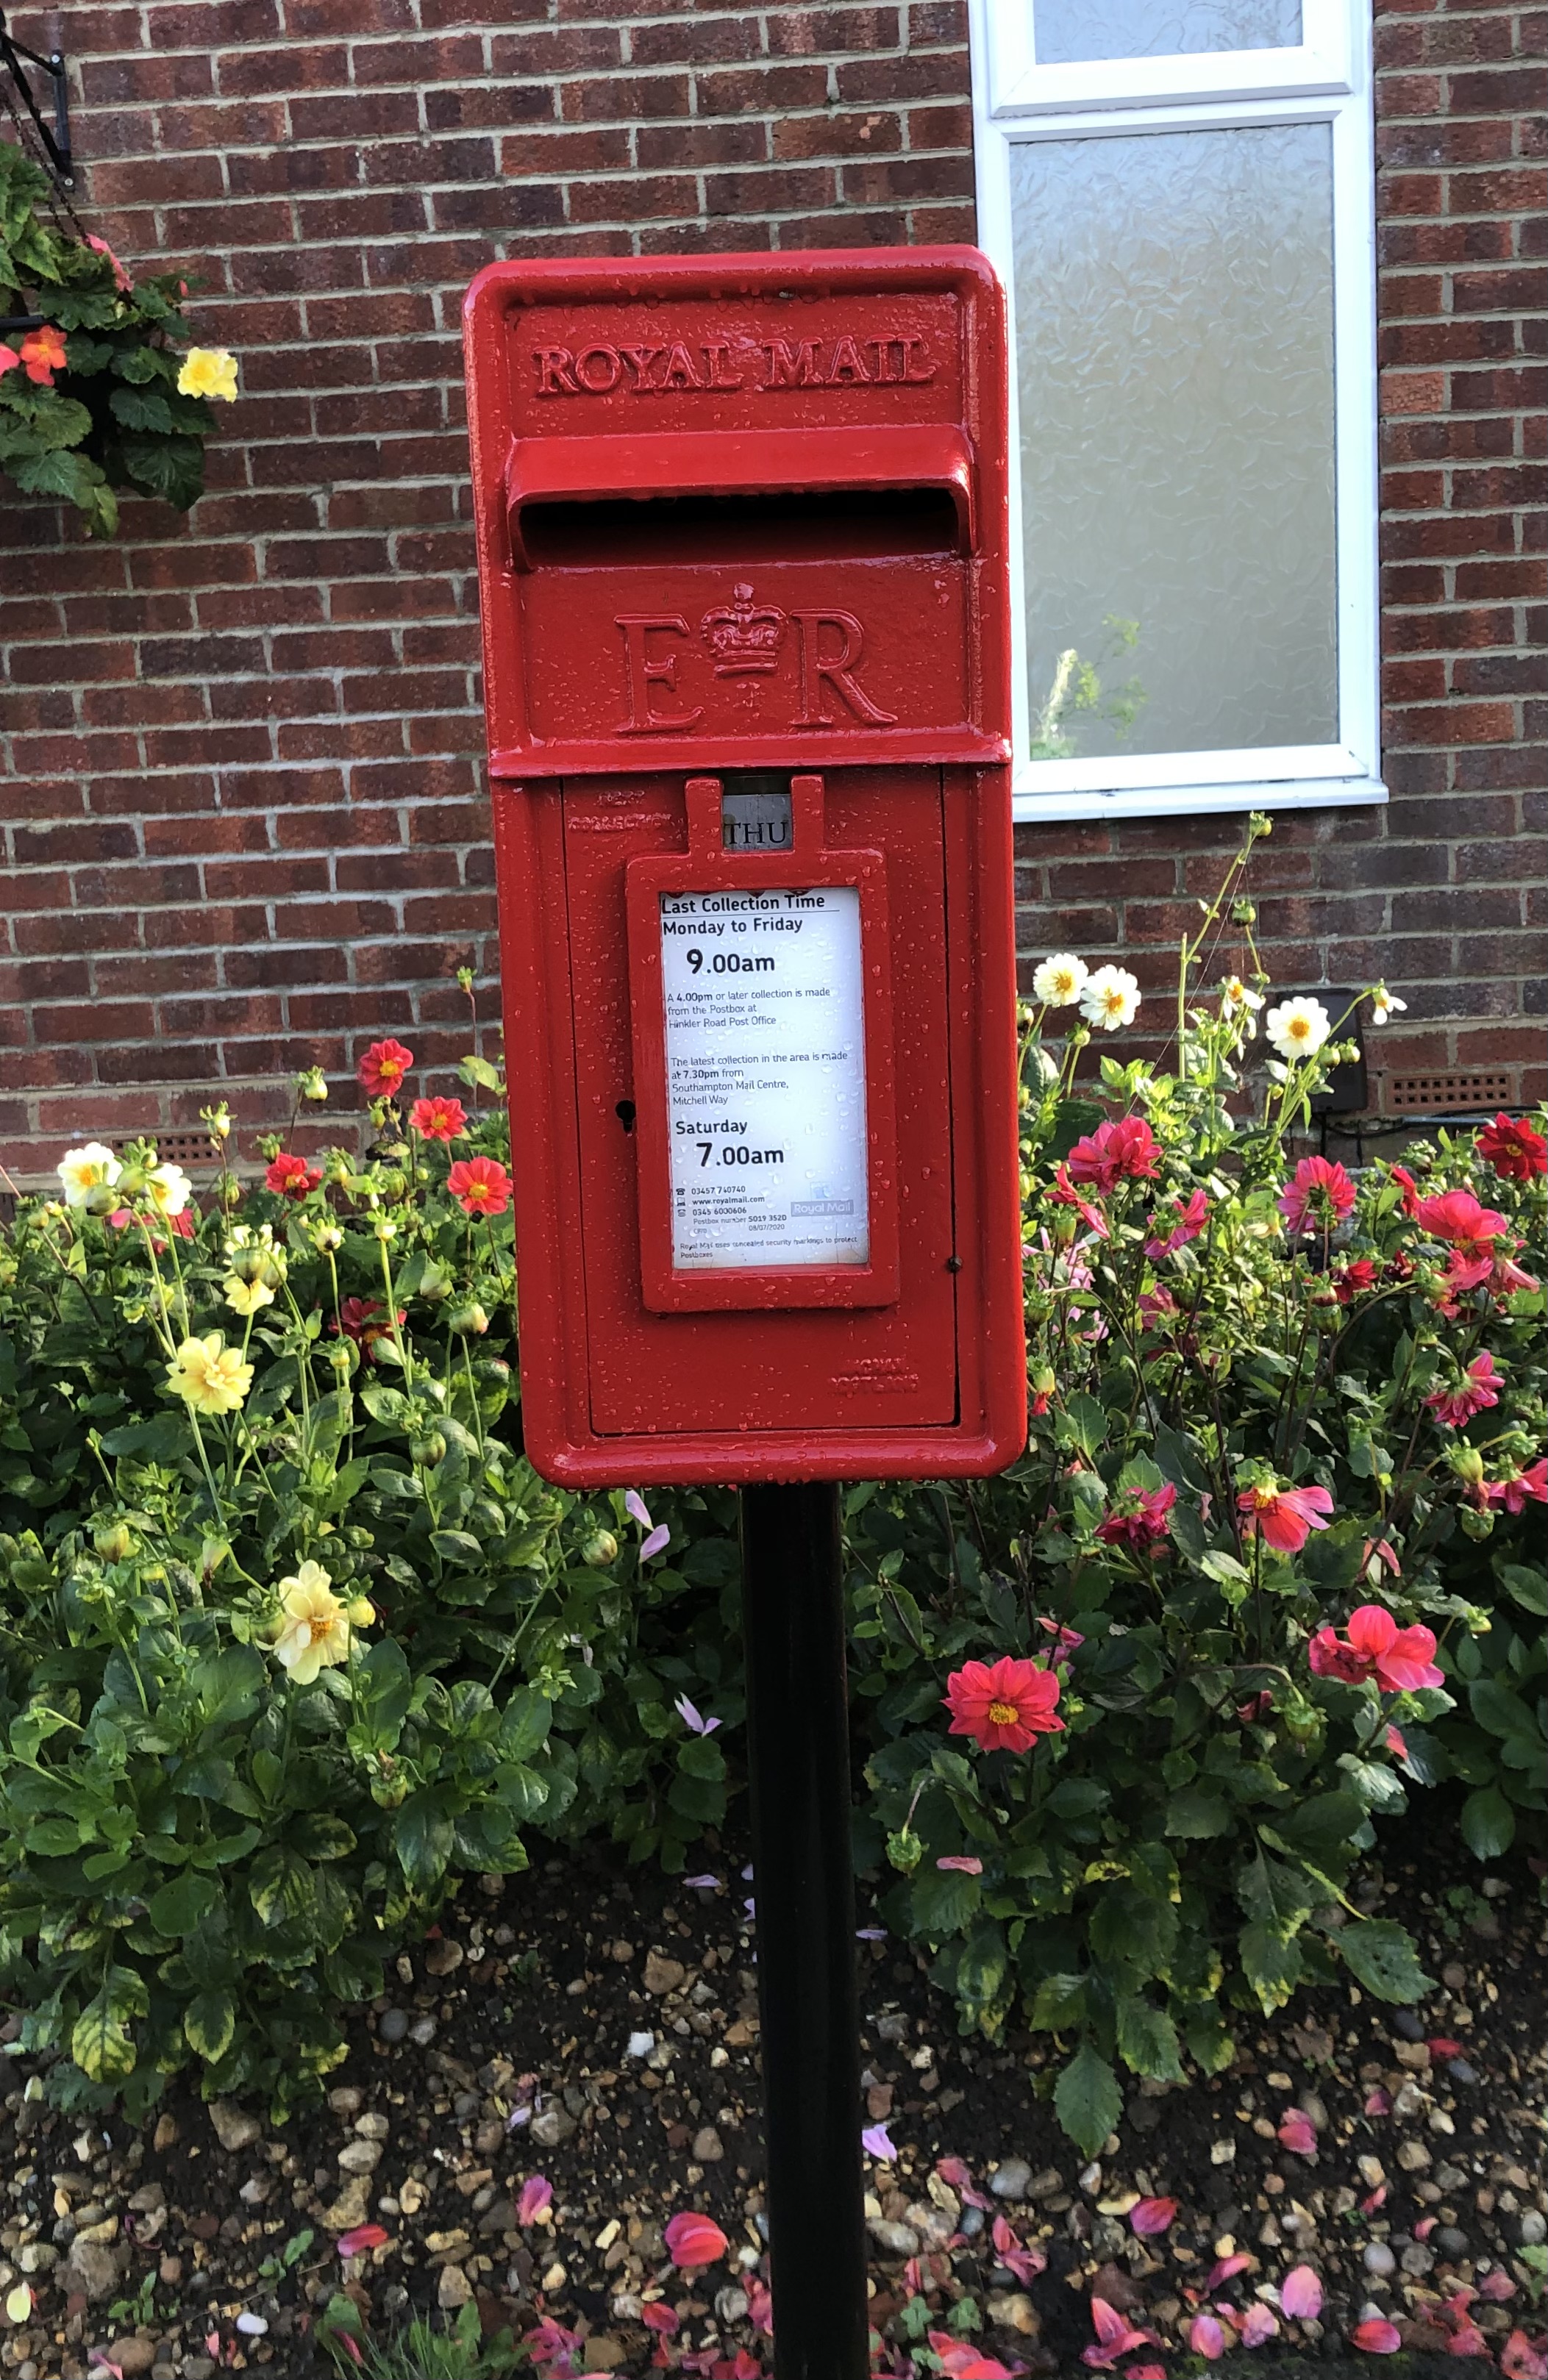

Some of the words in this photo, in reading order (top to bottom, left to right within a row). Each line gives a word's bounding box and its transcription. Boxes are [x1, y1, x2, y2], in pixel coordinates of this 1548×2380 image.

[532, 339, 743, 396] ROYAL
[759, 332, 937, 392] MAIL
[613, 613, 705, 734] E
[790, 607, 899, 726] R
[724, 821, 788, 844] THU
[662, 898, 696, 915] Last
[702, 896, 780, 913] Collection
[784, 894, 825, 910] Time
[663, 920, 725, 936] Monday
[731, 920, 747, 933] to
[754, 917, 803, 934] Friday
[686, 948, 775, 974] 9.00am
[667, 993, 674, 1003] A
[677, 993, 713, 1004] 4.00pm
[728, 990, 749, 1000] later
[751, 988, 793, 999] collection
[795, 988, 803, 998] is
[805, 987, 830, 997] made
[668, 1006, 690, 1015] from
[692, 1005, 707, 1015] the
[710, 1004, 745, 1014] Postbox
[747, 1004, 757, 1013] at
[669, 1018, 701, 1029] Hinkler
[703, 1018, 727, 1028] Road
[729, 1017, 749, 1027] Post
[751, 1016, 777, 1026] Office
[671, 1057, 688, 1067] The
[691, 1057, 715, 1066] latest
[718, 1054, 759, 1065] collection
[761, 1054, 770, 1063] in
[772, 1054, 788, 1063] the
[813, 1052, 820, 1061] is
[671, 1071, 682, 1080] at
[683, 1070, 719, 1081] 7.30pm
[721, 1068, 743, 1078] from
[672, 1082, 733, 1093] Southampton
[736, 1081, 755, 1090] Mail
[757, 1080, 789, 1090] Centre,
[673, 1096, 707, 1105] Mitchell
[710, 1096, 728, 1106] Way
[676, 1119, 748, 1135] Saturday
[696, 1142, 784, 1167] 7.00am
[692, 1196, 765, 1207] www.royalmail.com
[793, 1204, 824, 1214] Royal
[827, 1203, 850, 1212] Mail
[693, 1208, 712, 1216] 0345
[714, 1207, 747, 1215] 6000606
